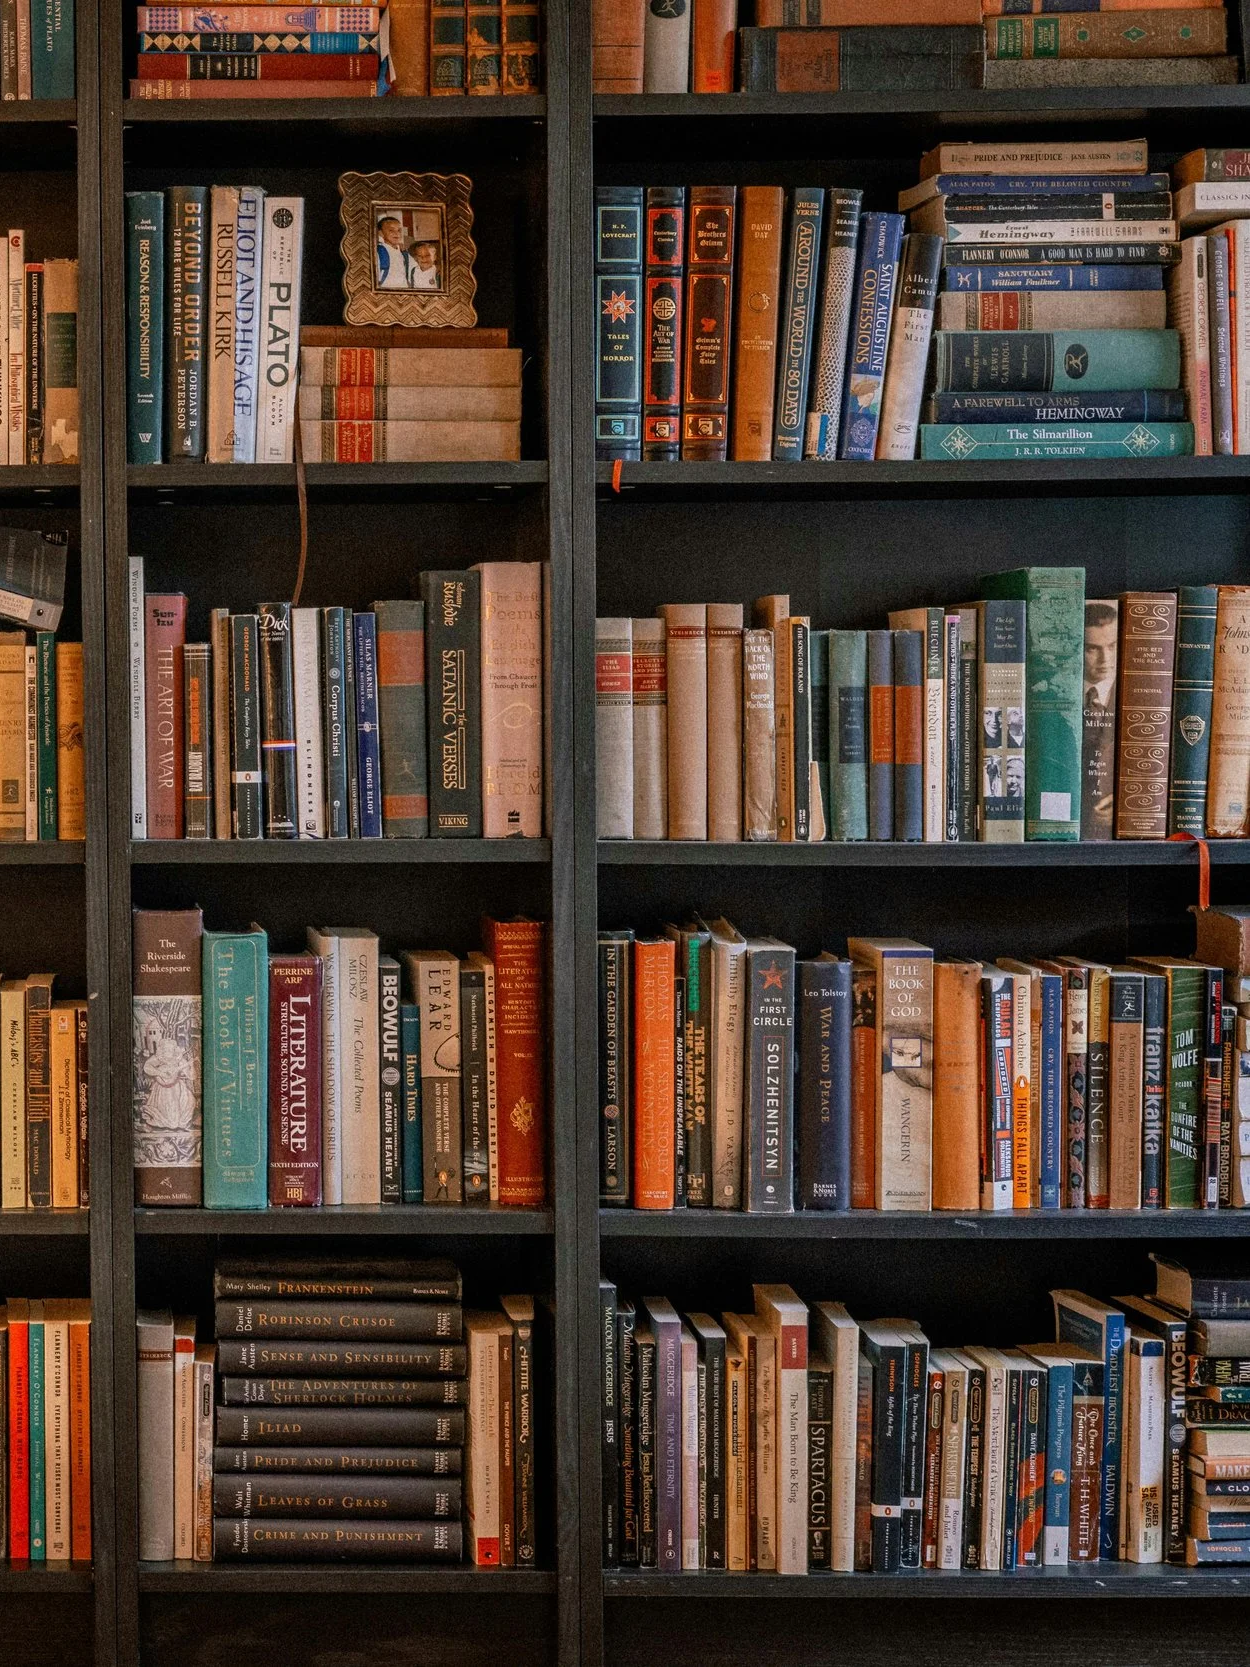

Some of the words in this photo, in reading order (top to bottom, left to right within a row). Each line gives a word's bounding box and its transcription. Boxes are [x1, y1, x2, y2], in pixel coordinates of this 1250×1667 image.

[973, 153, 997, 162] PRIDE
[1000, 153, 1018, 162] AND
[1020, 153, 1063, 162] PREJUDICE
[184, 202, 201, 284] BEYOND
[979, 229, 1056, 240] Hemingway
[139, 239, 150, 282] REASON
[216, 223, 234, 306] RUSSELL
[183, 294, 200, 362] ORDER
[855, 268, 877, 364] CONFESSIONS
[139, 295, 151, 380] RESPONSIBILITY
[214, 310, 232, 359] KIRK
[266, 282, 291, 387] PLATO
[177, 369, 185, 429] PETERSON
[1035, 406, 1125, 420] HEMINGWAY
[1006, 428, 1030, 440] The
[1032, 428, 1093, 439] Silmarillion
[1044, 446, 1086, 456] TOLKIEN
[158, 645, 174, 680] THE
[930, 619, 939, 675] BUECHNER
[158, 683, 174, 713] ART
[330, 685, 340, 721] Corpus
[442, 650, 457, 726] SATANIC
[158, 715, 174, 747] OF
[332, 722, 341, 757] Christi
[158, 749, 174, 790] WAR
[443, 729, 457, 790] VERSES
[438, 817, 469, 826] VIKING
[147, 952, 186, 960] Riverside
[158, 940, 176, 948] The
[140, 965, 191, 973] Shakespeare
[383, 975, 398, 1062] BEOWULF
[753, 1017, 793, 1026] CIRCLE
[759, 1006, 787, 1014] FIRST
[819, 1005, 832, 1038] WAR
[1144, 1026, 1164, 1083] franz
[1175, 1029, 1194, 1048] TOM
[290, 994, 311, 1153] LITERATURE
[820, 1045, 830, 1073] AND
[1171, 1049, 1198, 1069] WOLFE
[766, 1043, 779, 1170] SOLZHENITSYN
[819, 1080, 832, 1123] PEACE
[1016, 1097, 1027, 1133] THINGS
[1091, 1053, 1105, 1144] SILENCE
[1144, 1094, 1164, 1156] kafka
[1016, 1137, 1027, 1159] FALL
[1170, 1138, 1198, 1160] VANITIES
[1016, 1161, 1027, 1195] APART
[277, 1281, 374, 1295] FRANKENSTEIN
[258, 1313, 333, 1327] ROBINSON
[339, 1315, 396, 1328] CRUSOE
[261, 1350, 304, 1363] SENSE
[309, 1351, 338, 1363] AND
[344, 1351, 433, 1365] SENSIBILITY
[1170, 1330, 1186, 1418] BEOWULF
[258, 1421, 302, 1435] ILIAD
[605, 1420, 614, 1443] JESUS
[810, 1427, 825, 1524] SPARTACUS
[1105, 1464, 1116, 1516] BALDWIN
[253, 1529, 297, 1541] CRIME
[301, 1529, 329, 1541] AND
[334, 1529, 423, 1542] PUNISHMENT
[1079, 1503, 1090, 1545] WHITE
